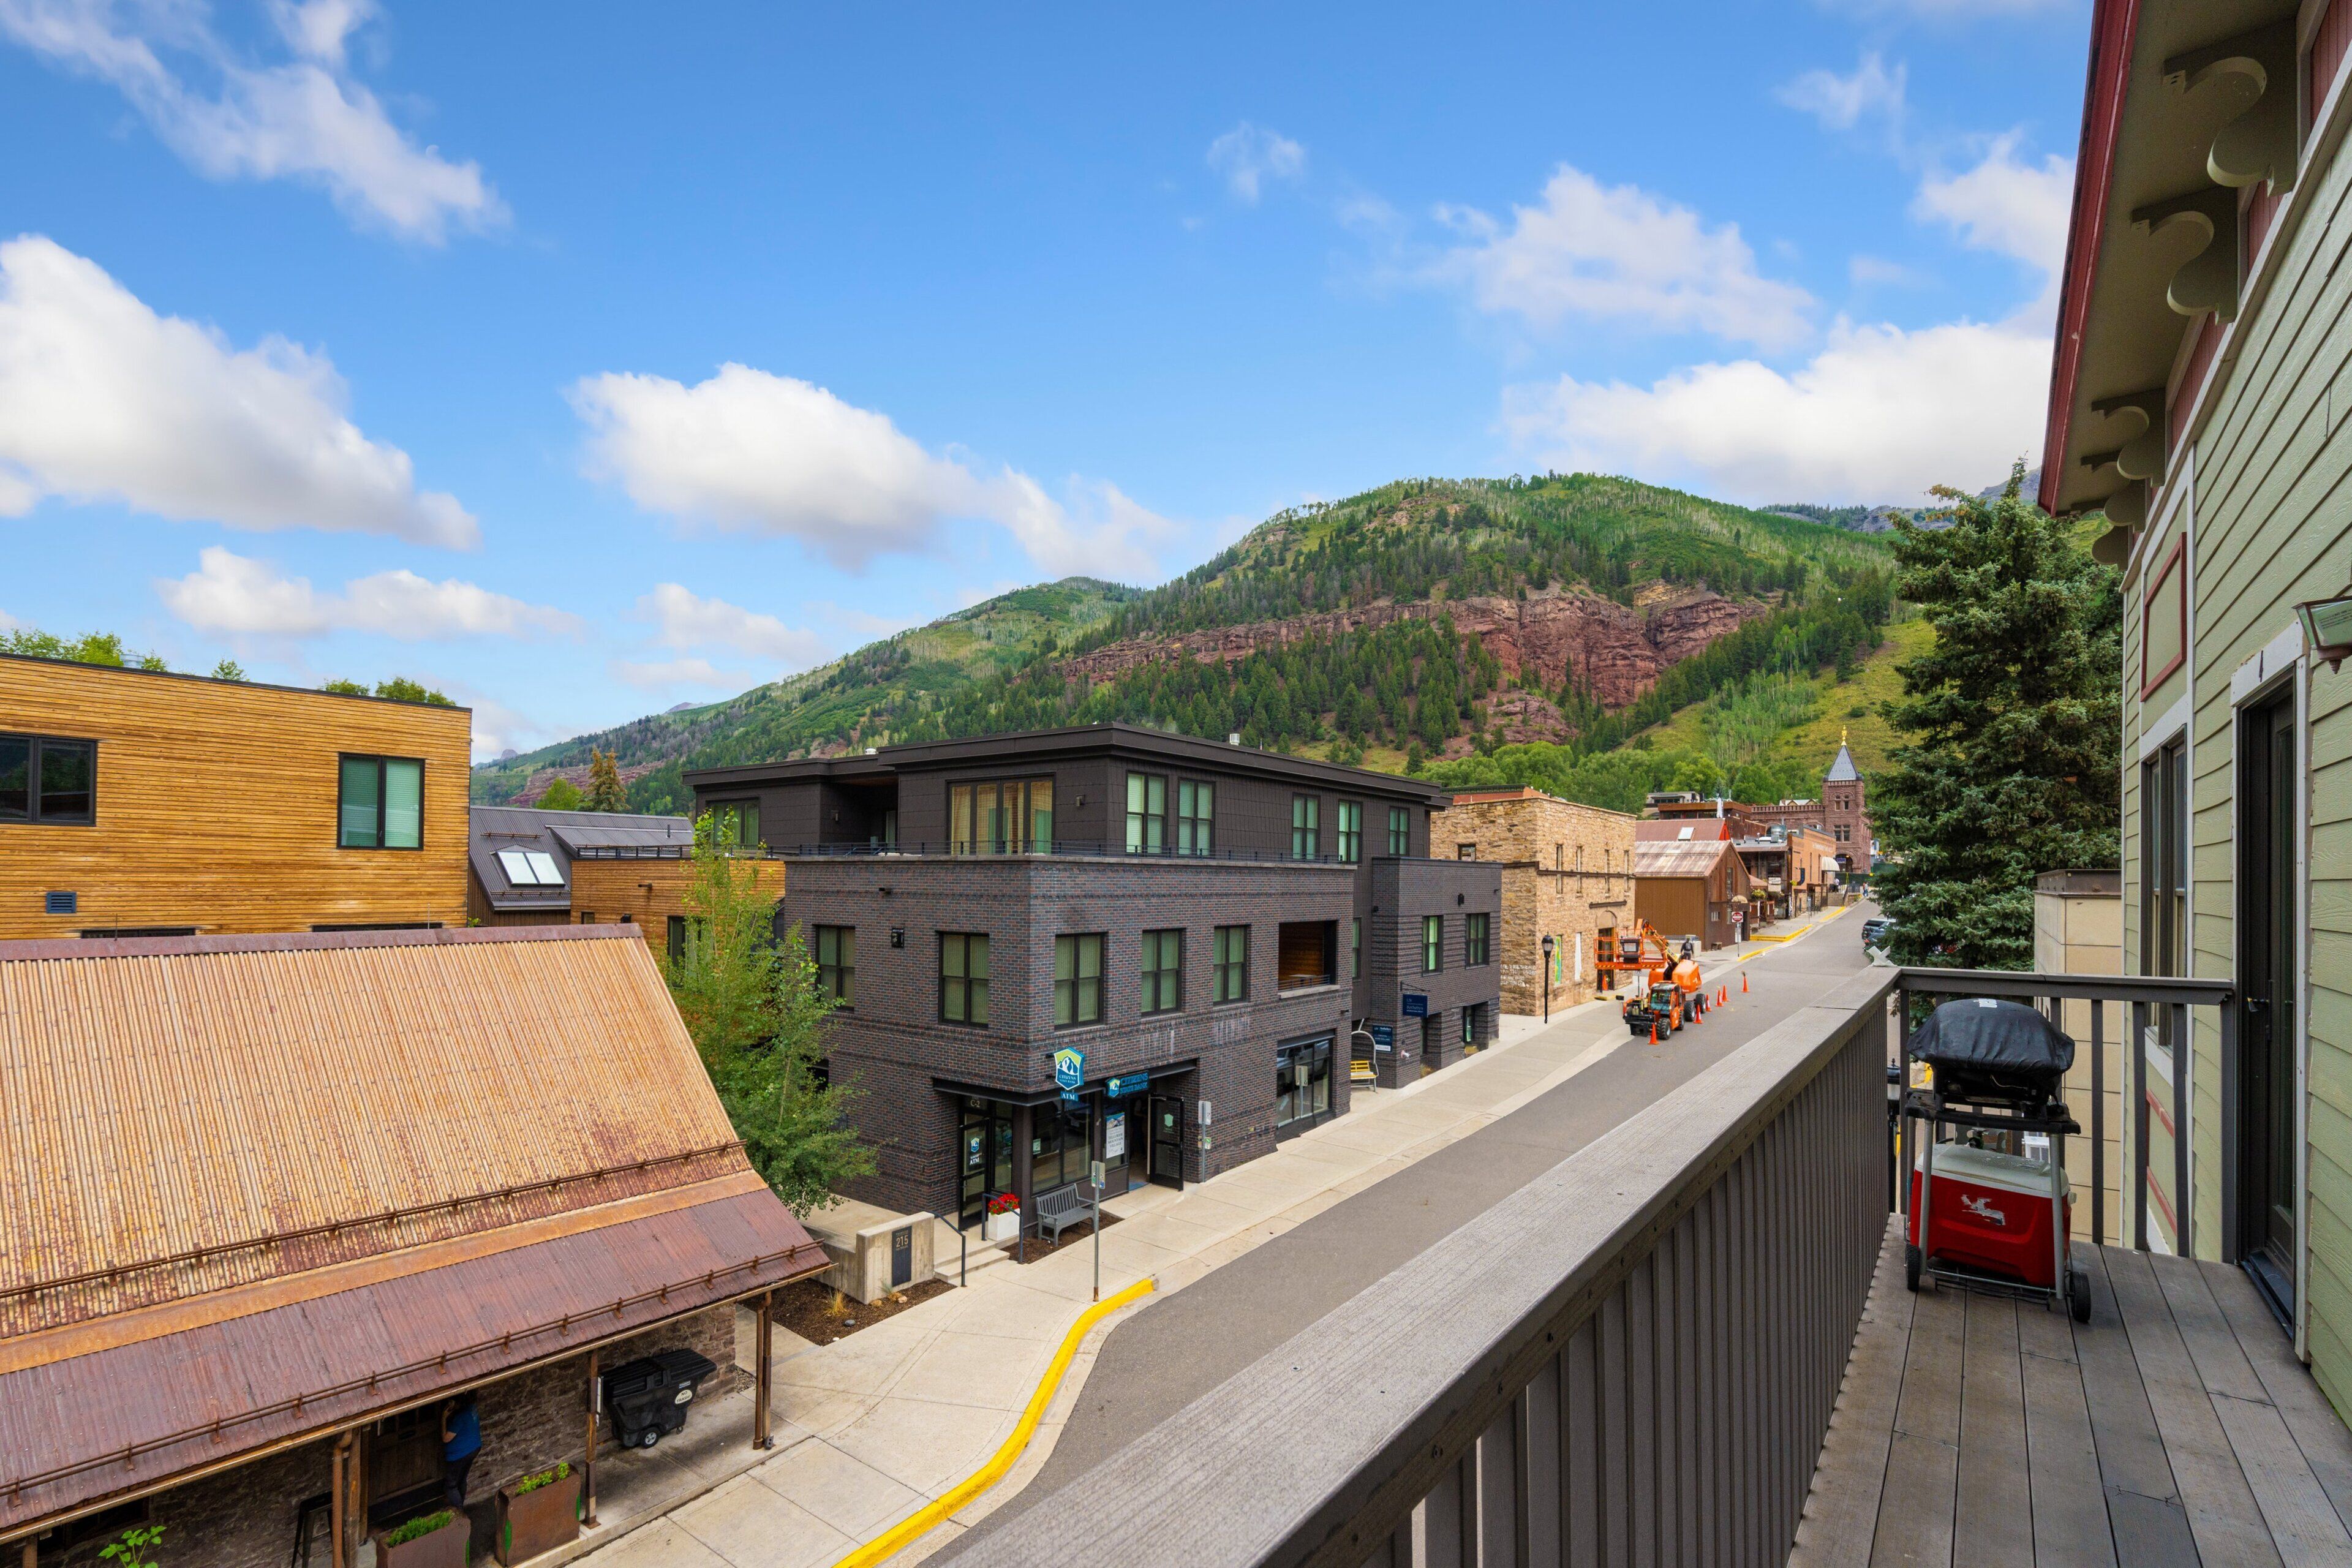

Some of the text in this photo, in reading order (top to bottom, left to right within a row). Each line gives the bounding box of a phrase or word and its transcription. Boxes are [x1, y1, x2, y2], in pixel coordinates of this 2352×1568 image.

[1120, 1072, 1148, 1086] CITIZENS
[1120, 1082, 1148, 1094] STATE BANK
[970, 1099, 980, 1108] C-2
[970, 1157, 980, 1166] ATM
[896, 1235, 909, 1248] 215
